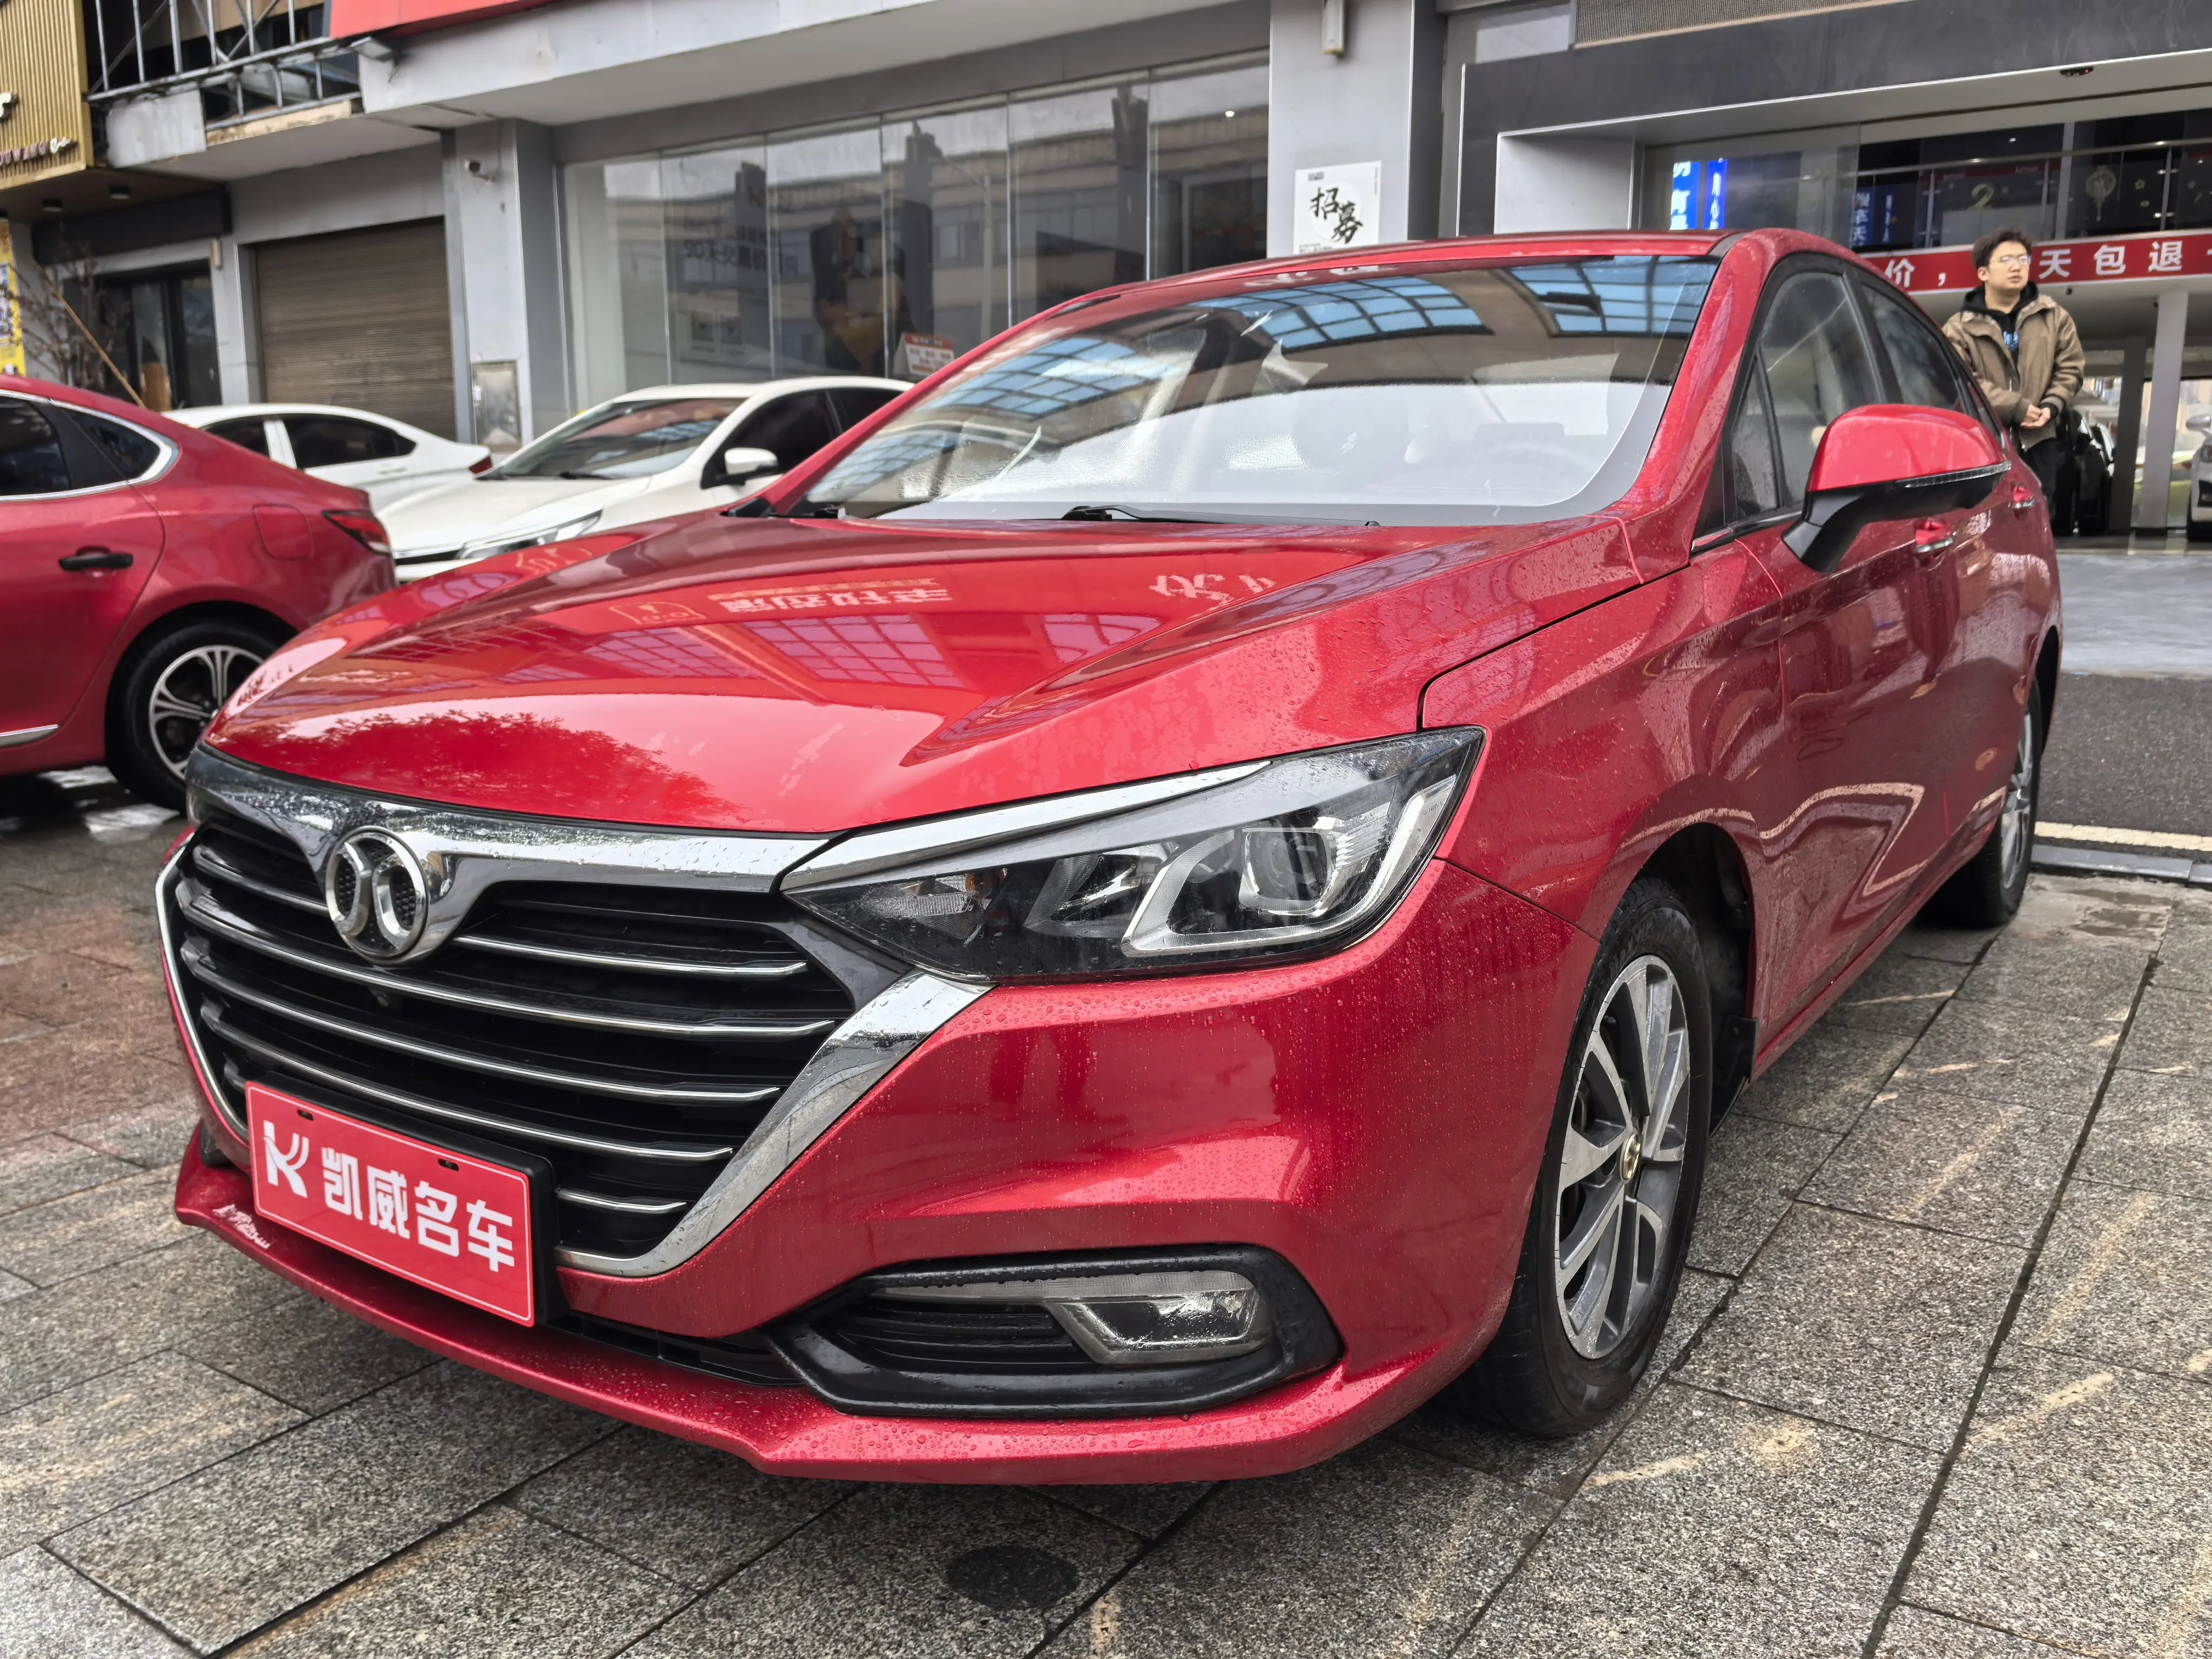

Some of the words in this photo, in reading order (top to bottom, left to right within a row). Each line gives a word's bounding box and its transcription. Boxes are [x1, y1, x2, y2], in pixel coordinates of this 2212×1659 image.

[1309, 186, 1364, 245] 招募
[321, 1147, 515, 1272] 凯威名车
